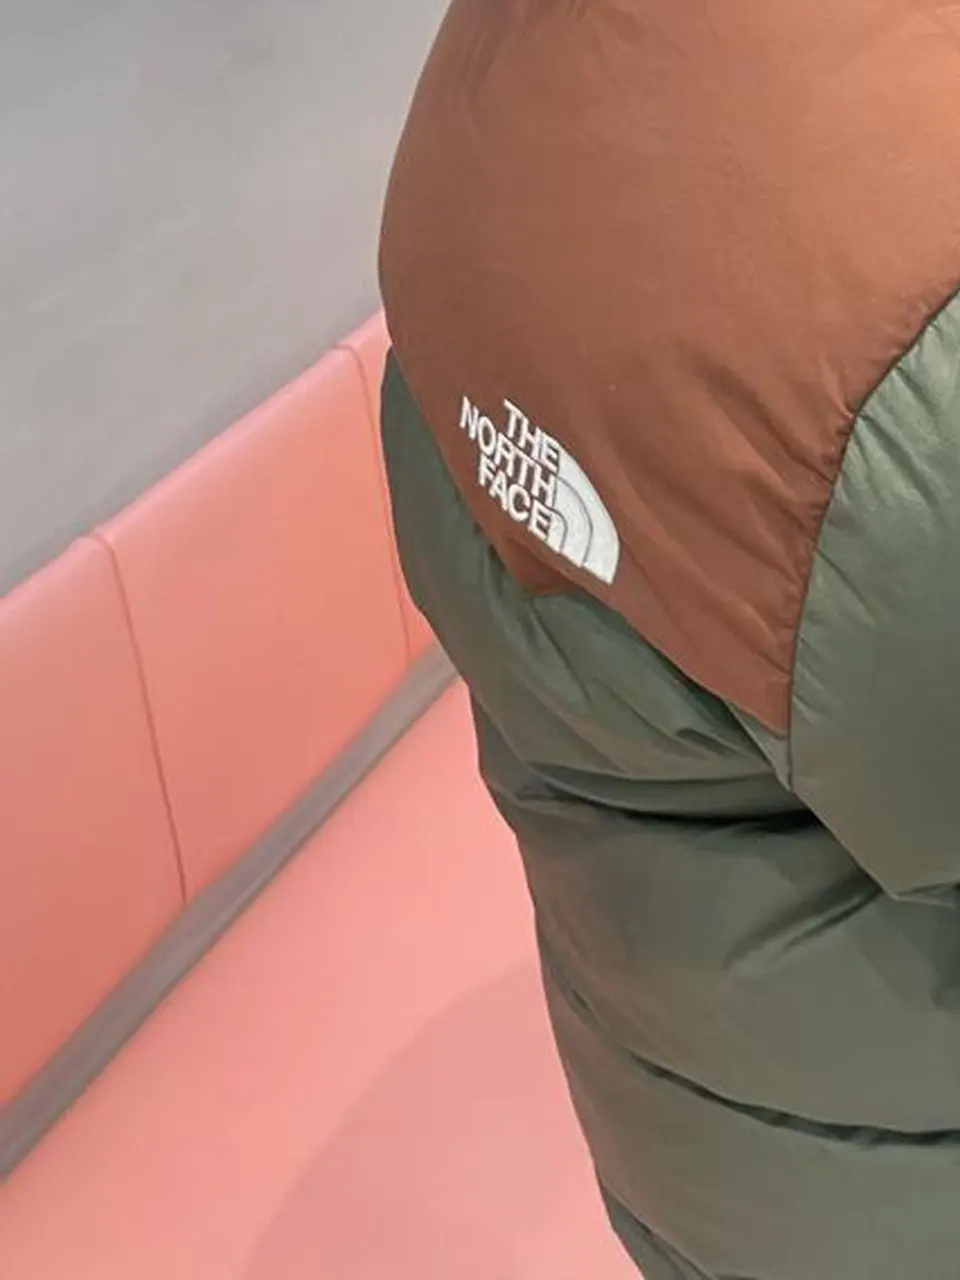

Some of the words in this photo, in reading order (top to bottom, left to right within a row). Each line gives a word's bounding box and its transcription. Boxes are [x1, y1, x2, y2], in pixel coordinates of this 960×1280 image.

[459, 395, 557, 508] NORTH
[504, 397, 560, 471] THE
[479, 453, 552, 542] FACE
